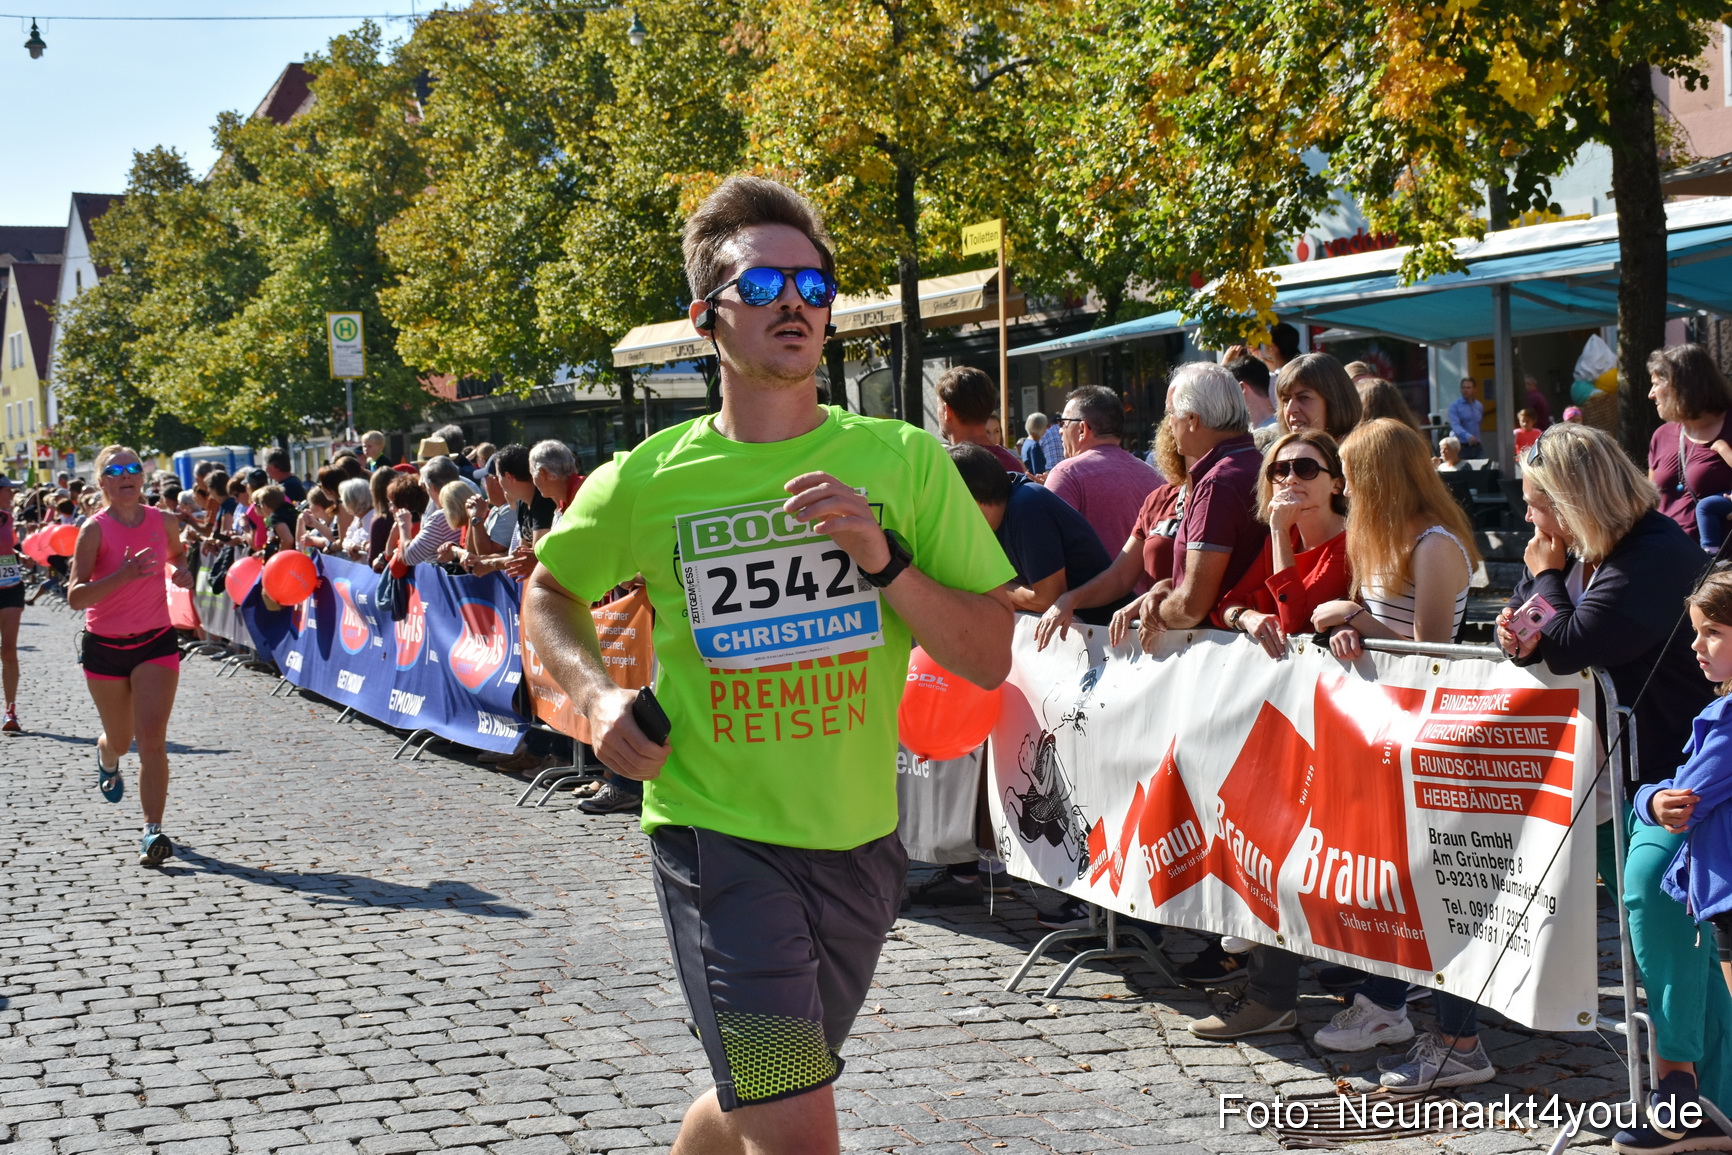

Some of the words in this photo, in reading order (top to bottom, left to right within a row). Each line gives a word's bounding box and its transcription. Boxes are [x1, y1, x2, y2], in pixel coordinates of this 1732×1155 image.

[969, 231, 999, 246] Toiletten
[1324, 227, 1400, 258] vodafo
[693, 509, 820, 552] BOC
[0, 567, 16, 578] 29
[706, 549, 855, 616] 2542
[605, 610, 630, 620] Partner
[712, 610, 862, 653] CHRISTIAN
[600, 640, 626, 651] nternet,
[611, 655, 638, 669] angeht.
[710, 666, 867, 710] PREMIUM
[906, 664, 949, 688] ÖDL
[1439, 693, 1512, 712] BINDESTRICKE
[712, 698, 866, 743] REISEN
[1423, 723, 1550, 745] VERZURRSYSTEME
[897, 751, 930, 779] e.de
[1418, 754, 1543, 779] RUNDSCHLINGEN
[1299, 788, 1309, 806] Seit
[1305, 765, 1315, 787] 1929
[1422, 787, 1524, 811] HEBEBÄNDER
[1140, 819, 1202, 881] Braun
[1216, 795, 1273, 895] Braun
[1428, 827, 1468, 847] Braun
[1470, 831, 1514, 850] GmbH
[1168, 863, 1188, 879] Sicher
[1187, 856, 1197, 868] ist
[1298, 826, 1407, 915] Braun
[1432, 849, 1454, 867] Am
[1456, 851, 1515, 876] Grünberg
[1517, 857, 1523, 874] 8
[1250, 883, 1259, 898] ist
[1435, 869, 1489, 889] D-92318
[1339, 911, 1373, 932] Sicher
[1374, 917, 1391, 934] ist
[1391, 921, 1426, 941] sicher
[1442, 897, 1468, 915] Tel.
[1468, 900, 1499, 922] 09181
[1506, 908, 1530, 934] 2307-0
[1447, 917, 1471, 937] Fax
[1473, 921, 1499, 945] 09181
